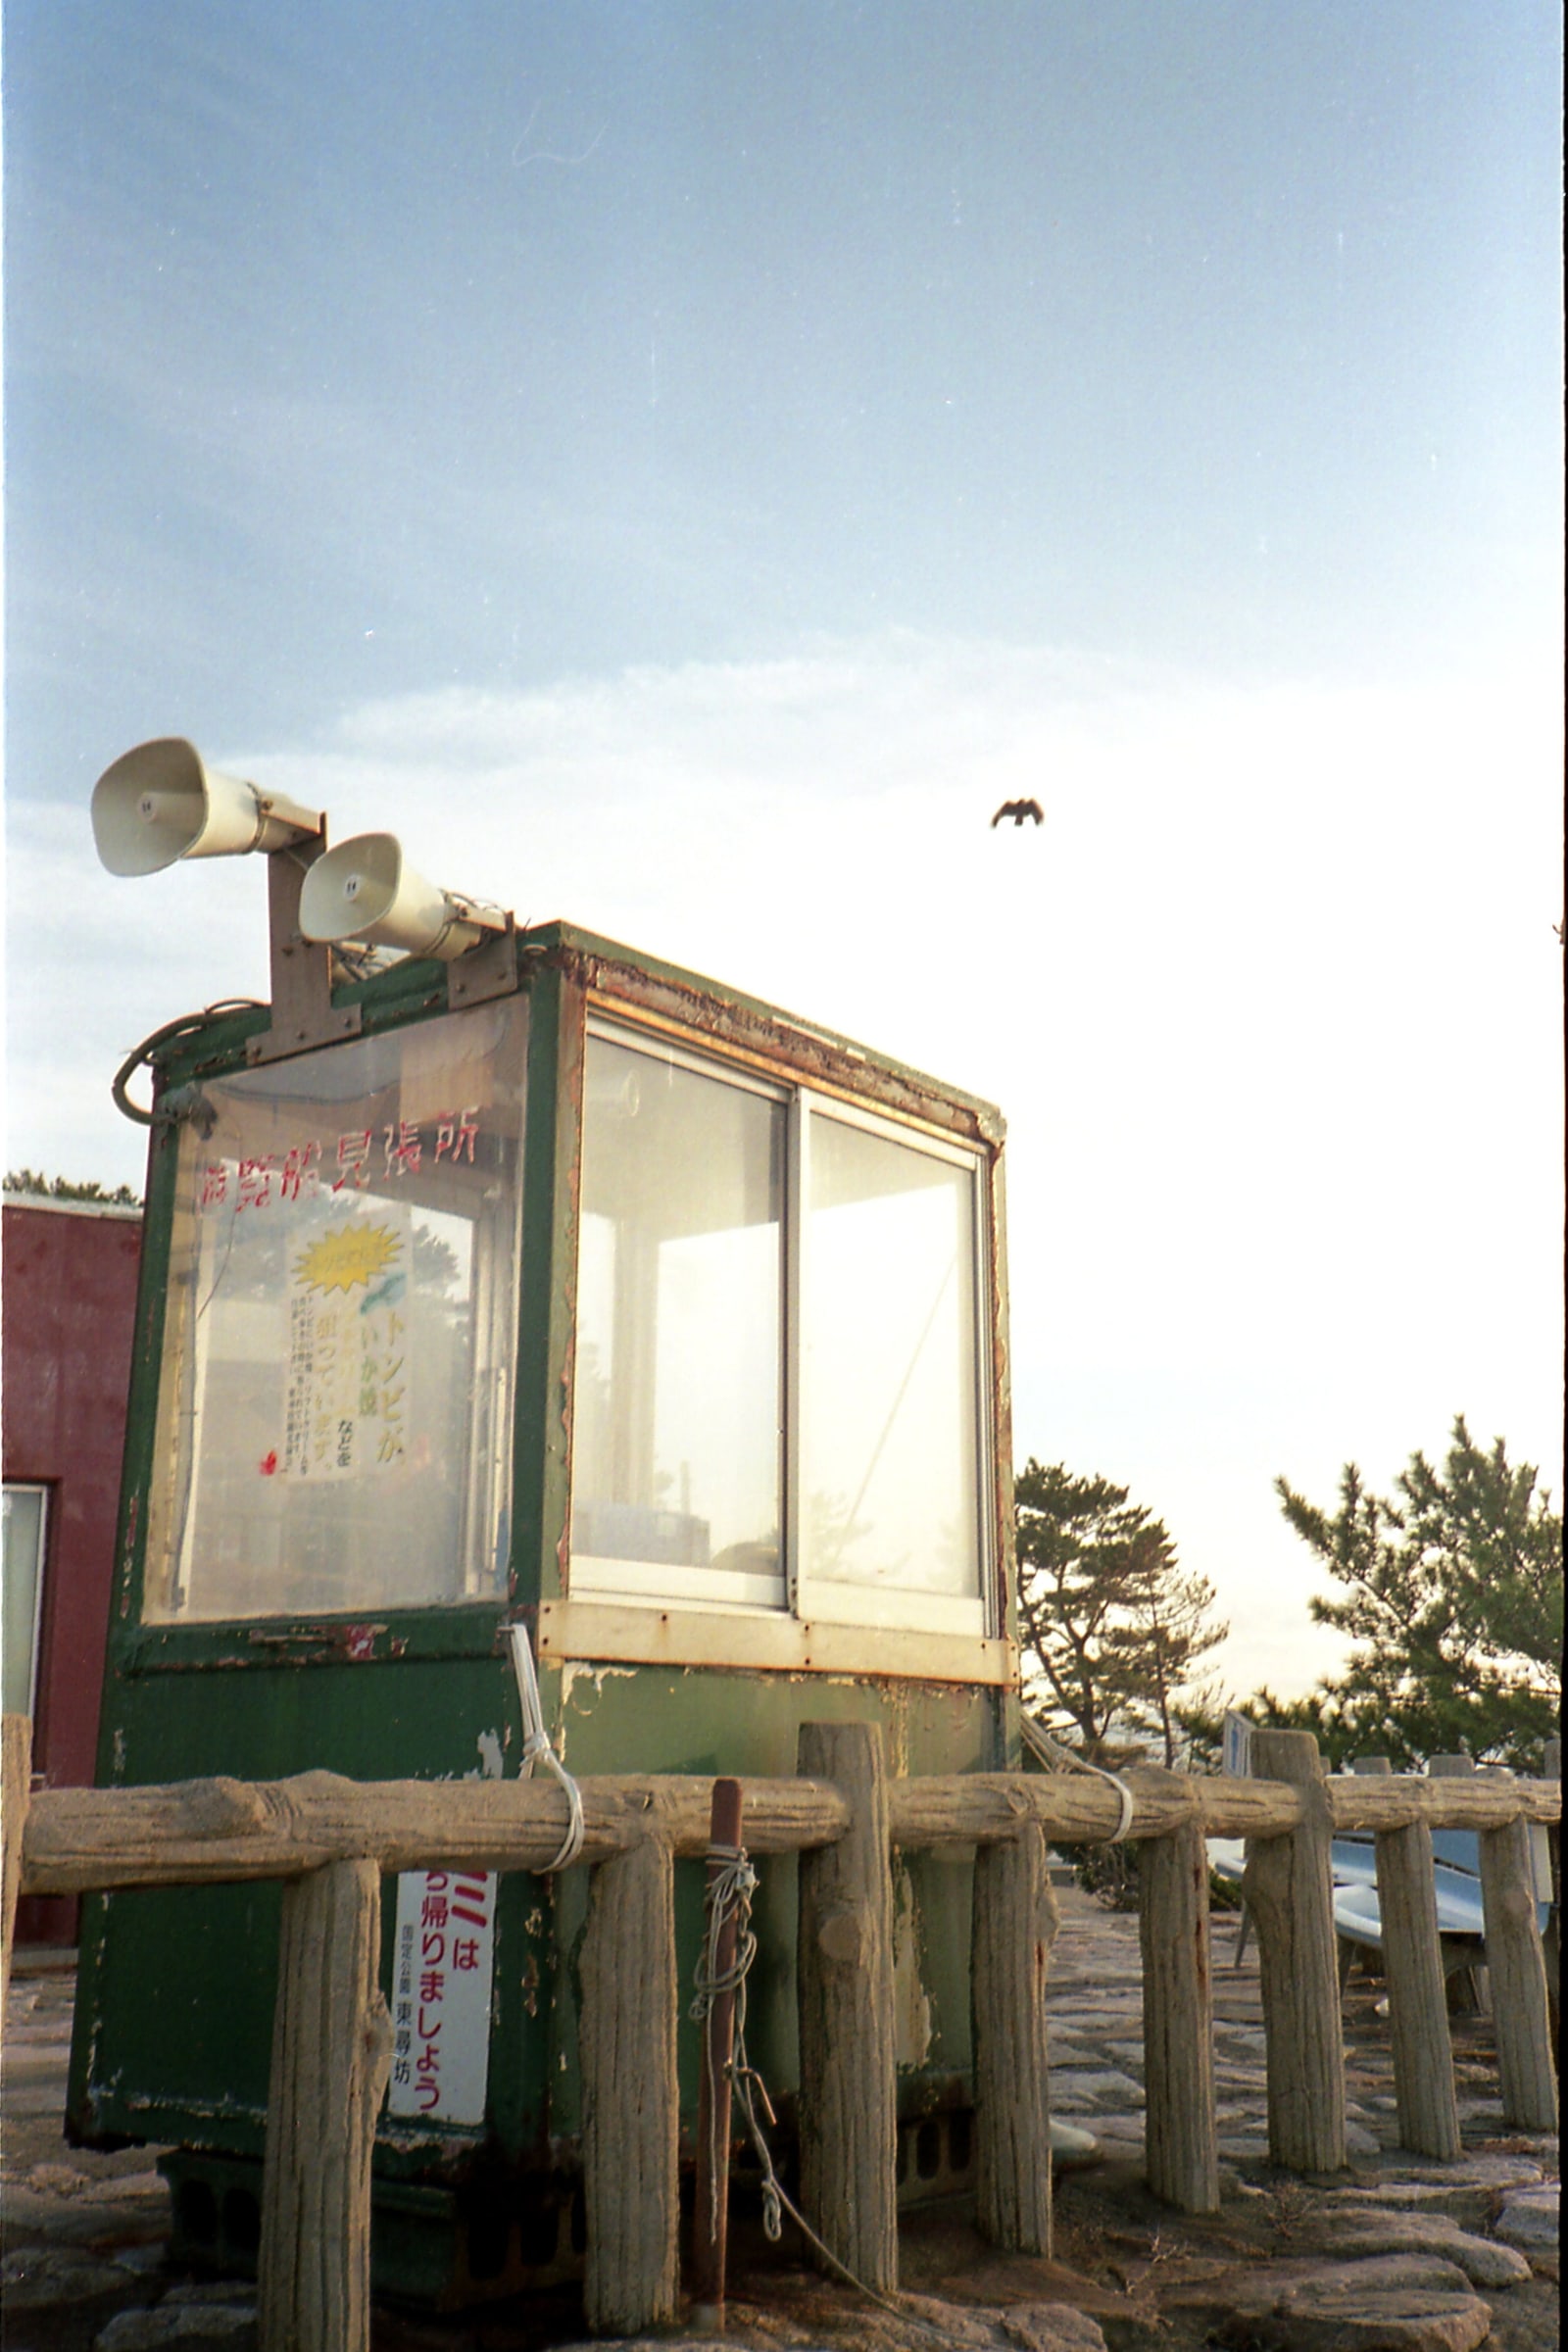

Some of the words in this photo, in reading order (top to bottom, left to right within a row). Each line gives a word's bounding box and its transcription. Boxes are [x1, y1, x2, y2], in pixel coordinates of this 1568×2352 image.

[375, 1309, 406, 1464] トンビが
[399, 1923, 414, 1995] 国定公園
[394, 2001, 413, 2086] 東尋坊
